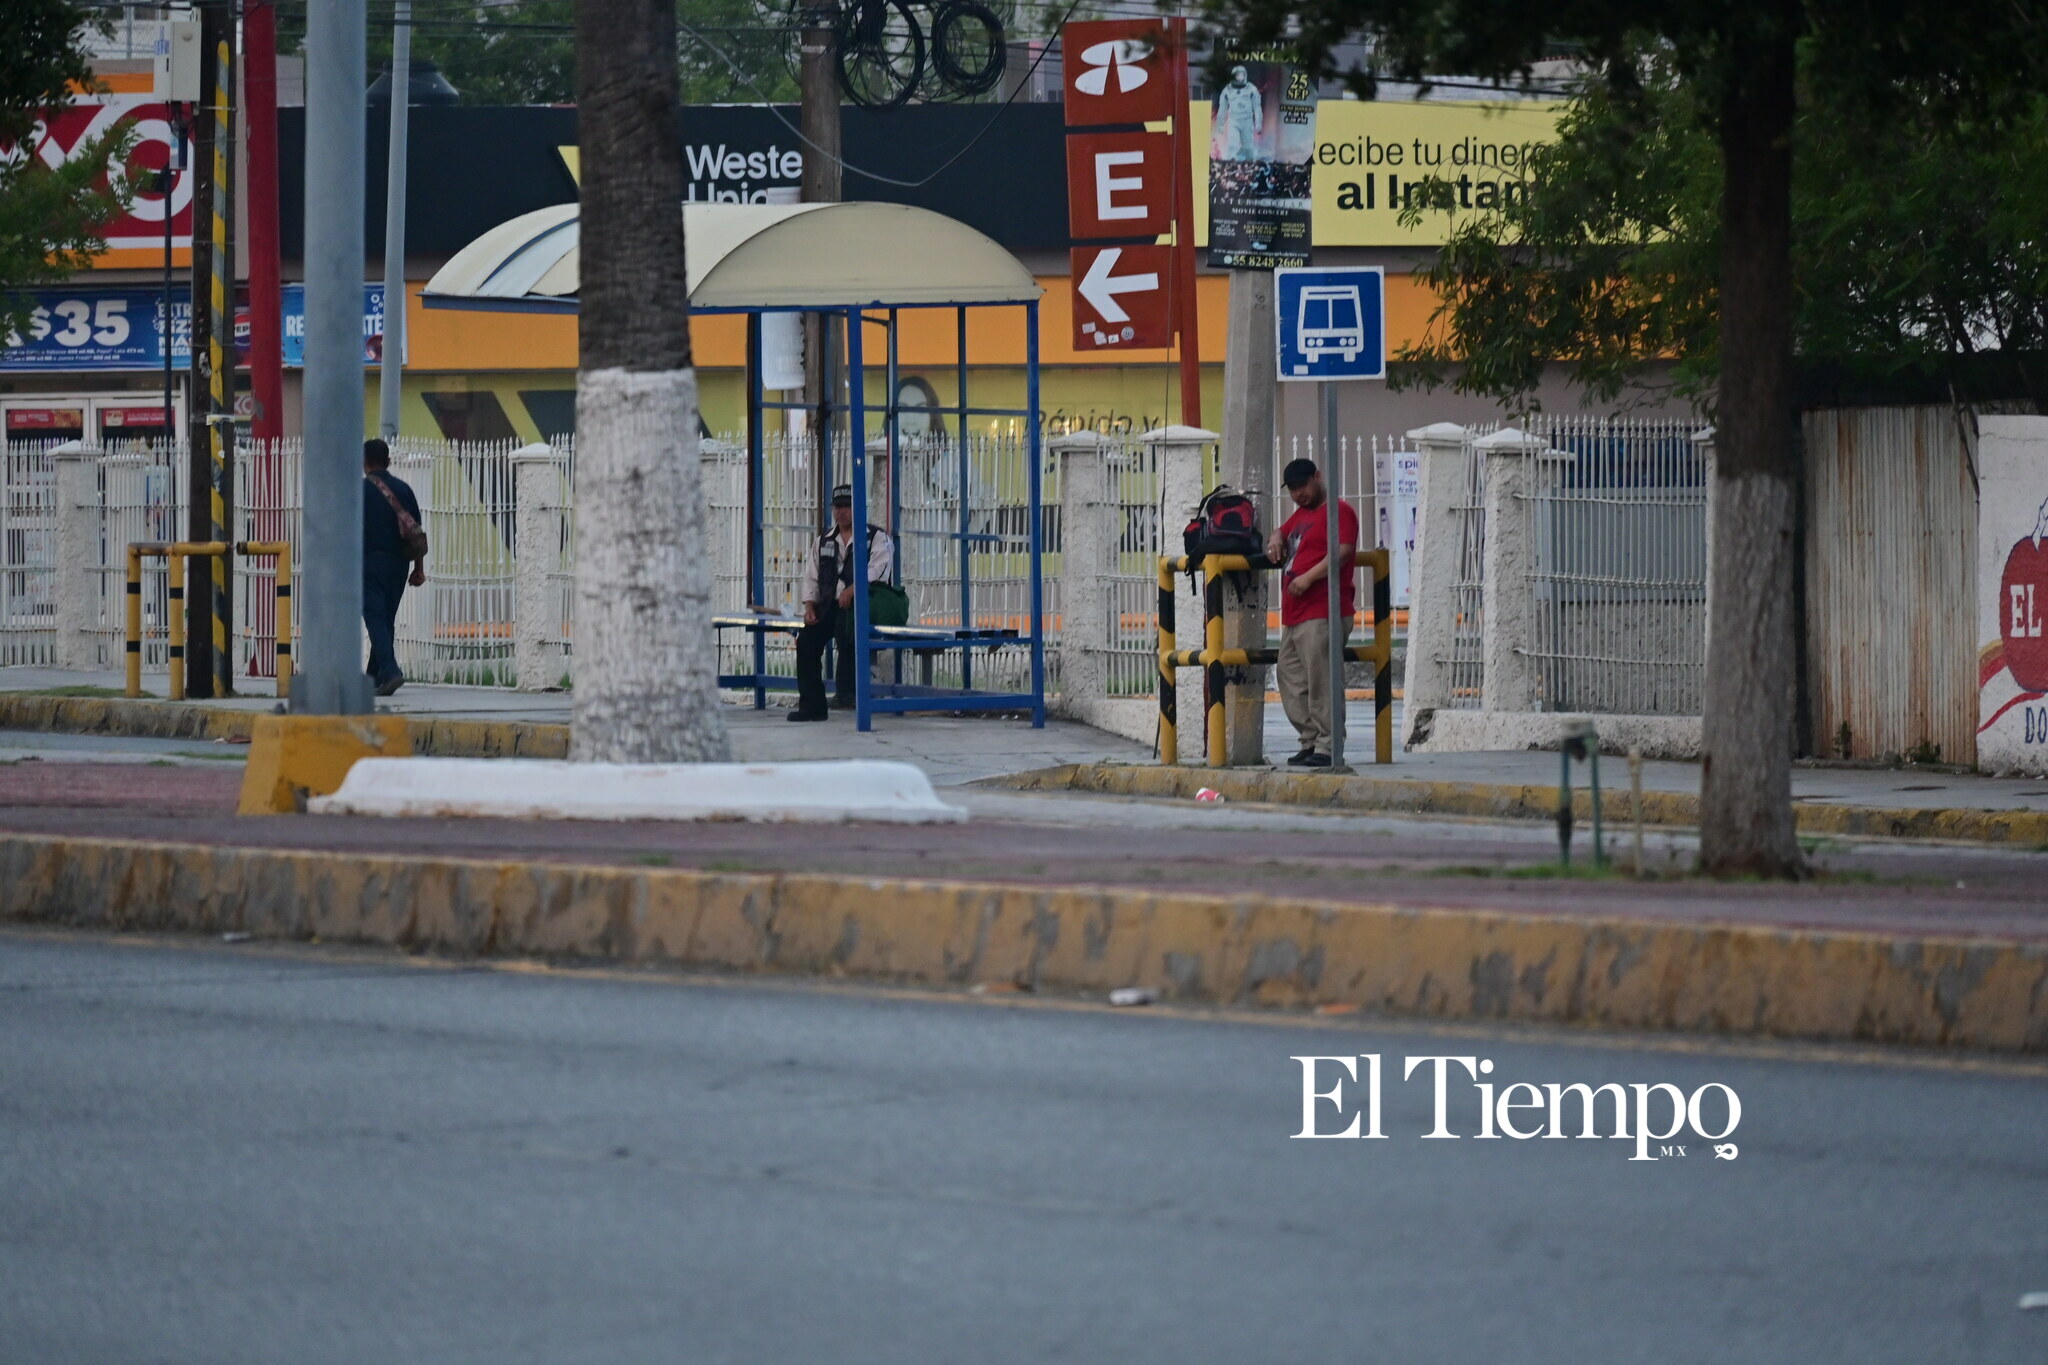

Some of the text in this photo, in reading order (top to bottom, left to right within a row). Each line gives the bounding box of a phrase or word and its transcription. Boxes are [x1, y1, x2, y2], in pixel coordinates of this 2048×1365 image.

[1288, 89, 1309, 99] SEP
[1291, 73, 1308, 89] 25
[686, 144, 803, 180] Weste
[1312, 136, 1403, 166] ecibe
[1413, 138, 1441, 166] tu
[1095, 151, 1148, 220] E
[1337, 173, 1375, 210] al
[1232, 207, 1288, 216] MOVIE CONCERT
[1233, 255, 1304, 268] 55 8248 2660
[2010, 584, 2042, 638] EL
